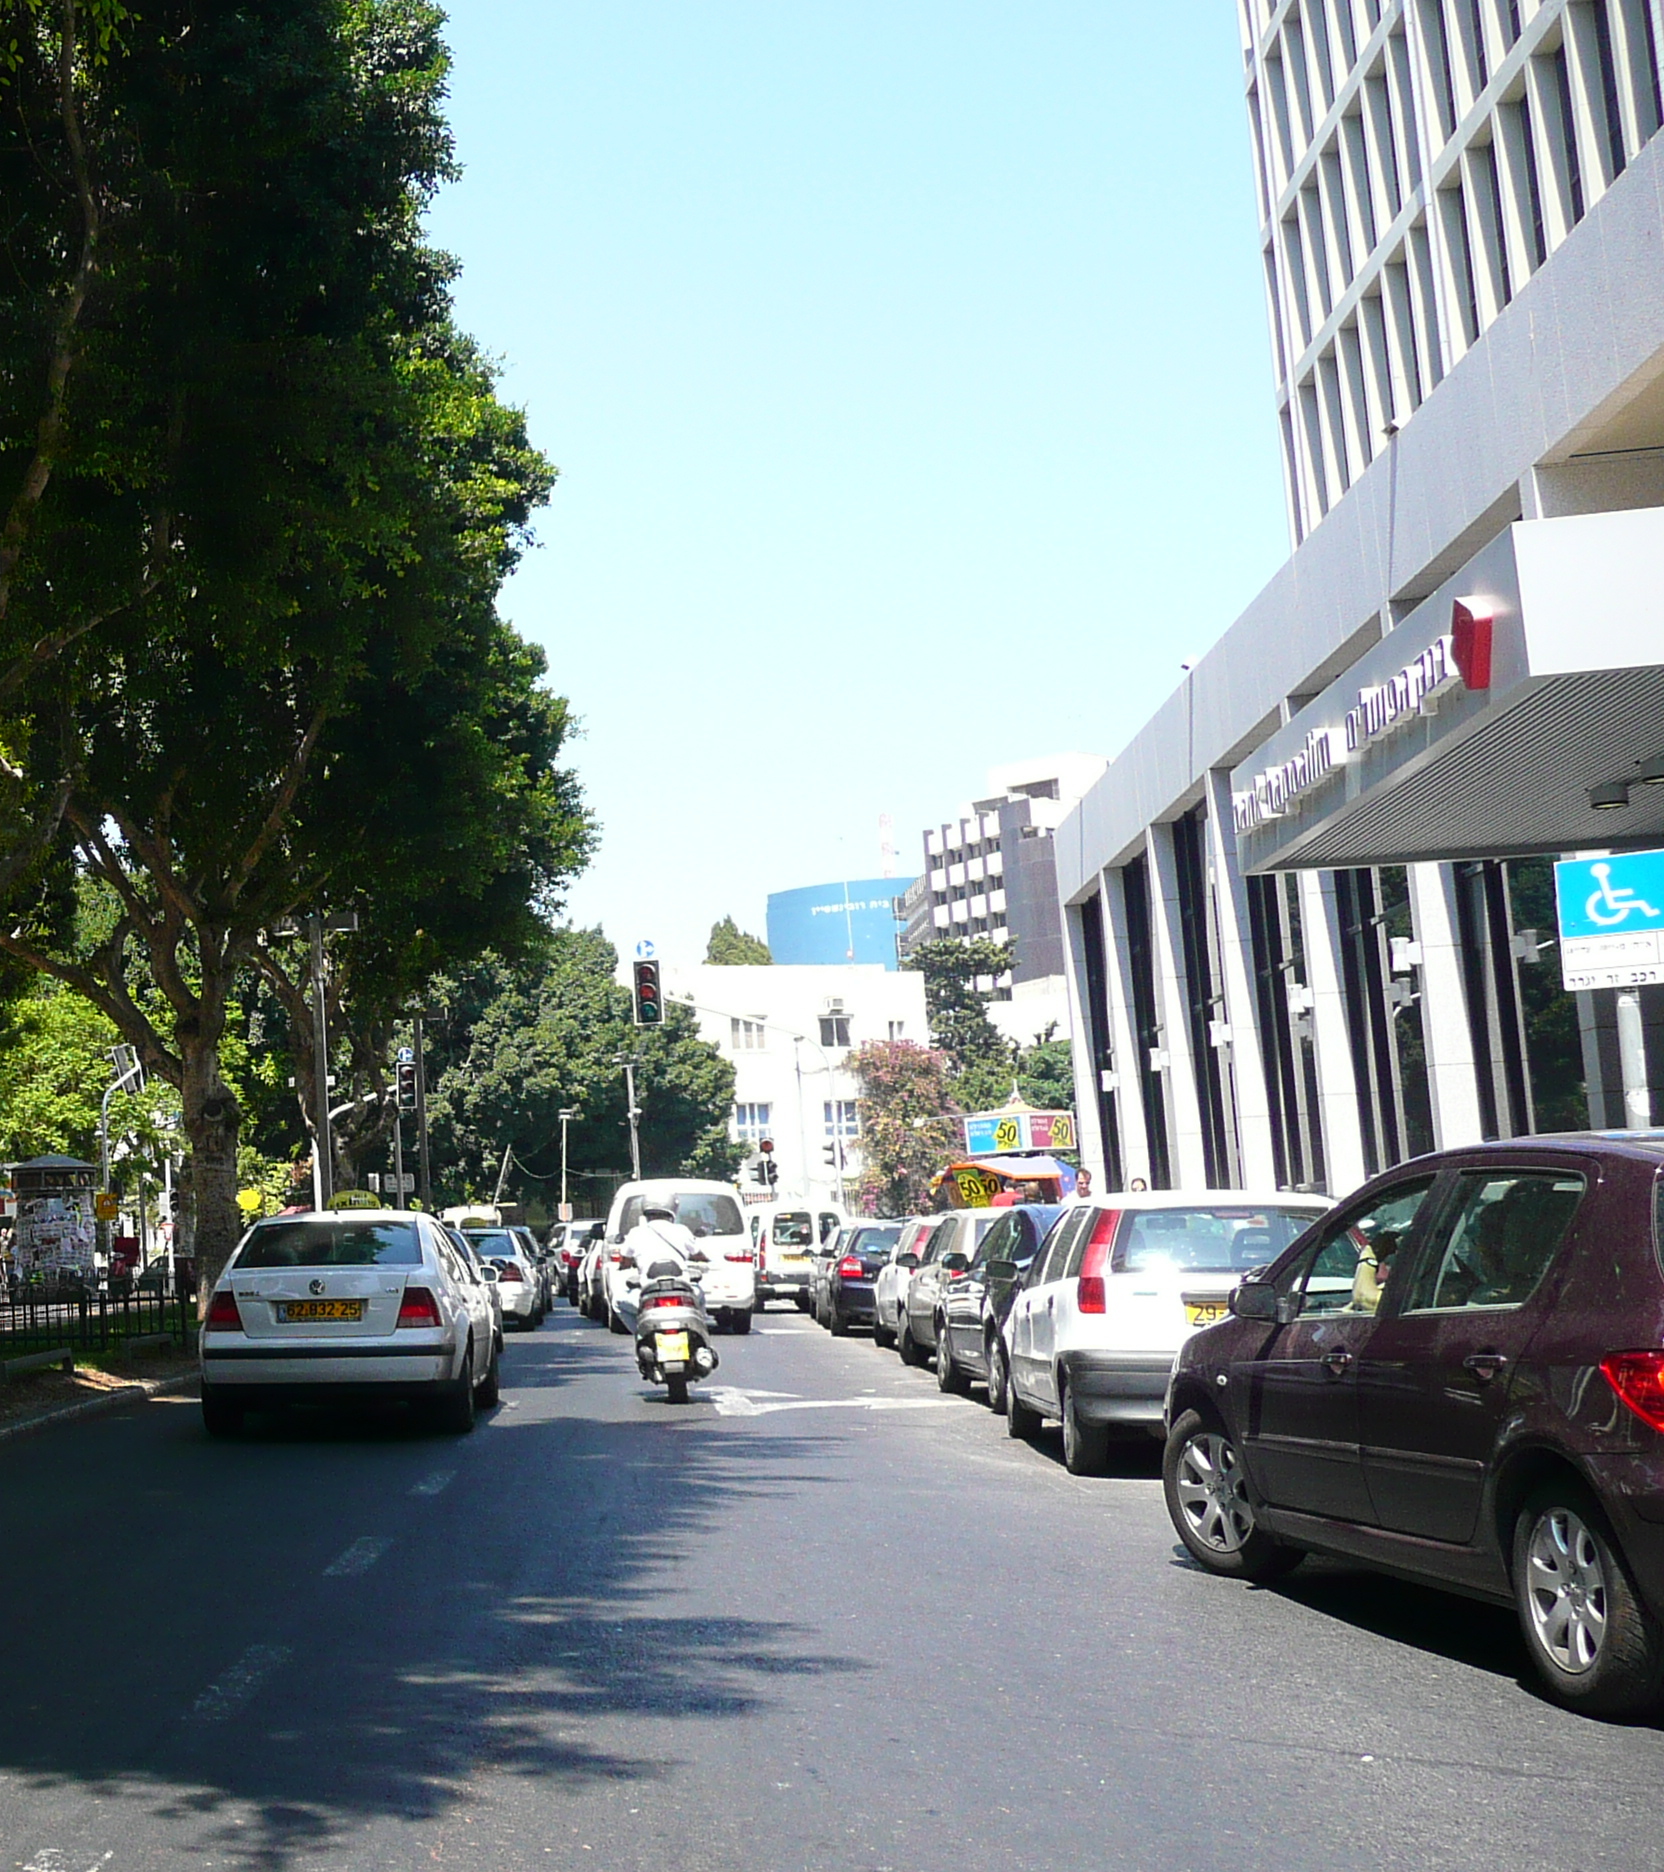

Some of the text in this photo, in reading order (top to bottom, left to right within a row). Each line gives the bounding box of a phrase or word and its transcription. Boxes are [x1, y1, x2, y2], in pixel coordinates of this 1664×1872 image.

[1413, 636, 1451, 714] בנק
[1630, 971, 1656, 983] רכב
[996, 1122, 1017, 1142] 50
[1053, 1119, 1069, 1140] 50
[960, 1179, 981, 1197] 50
